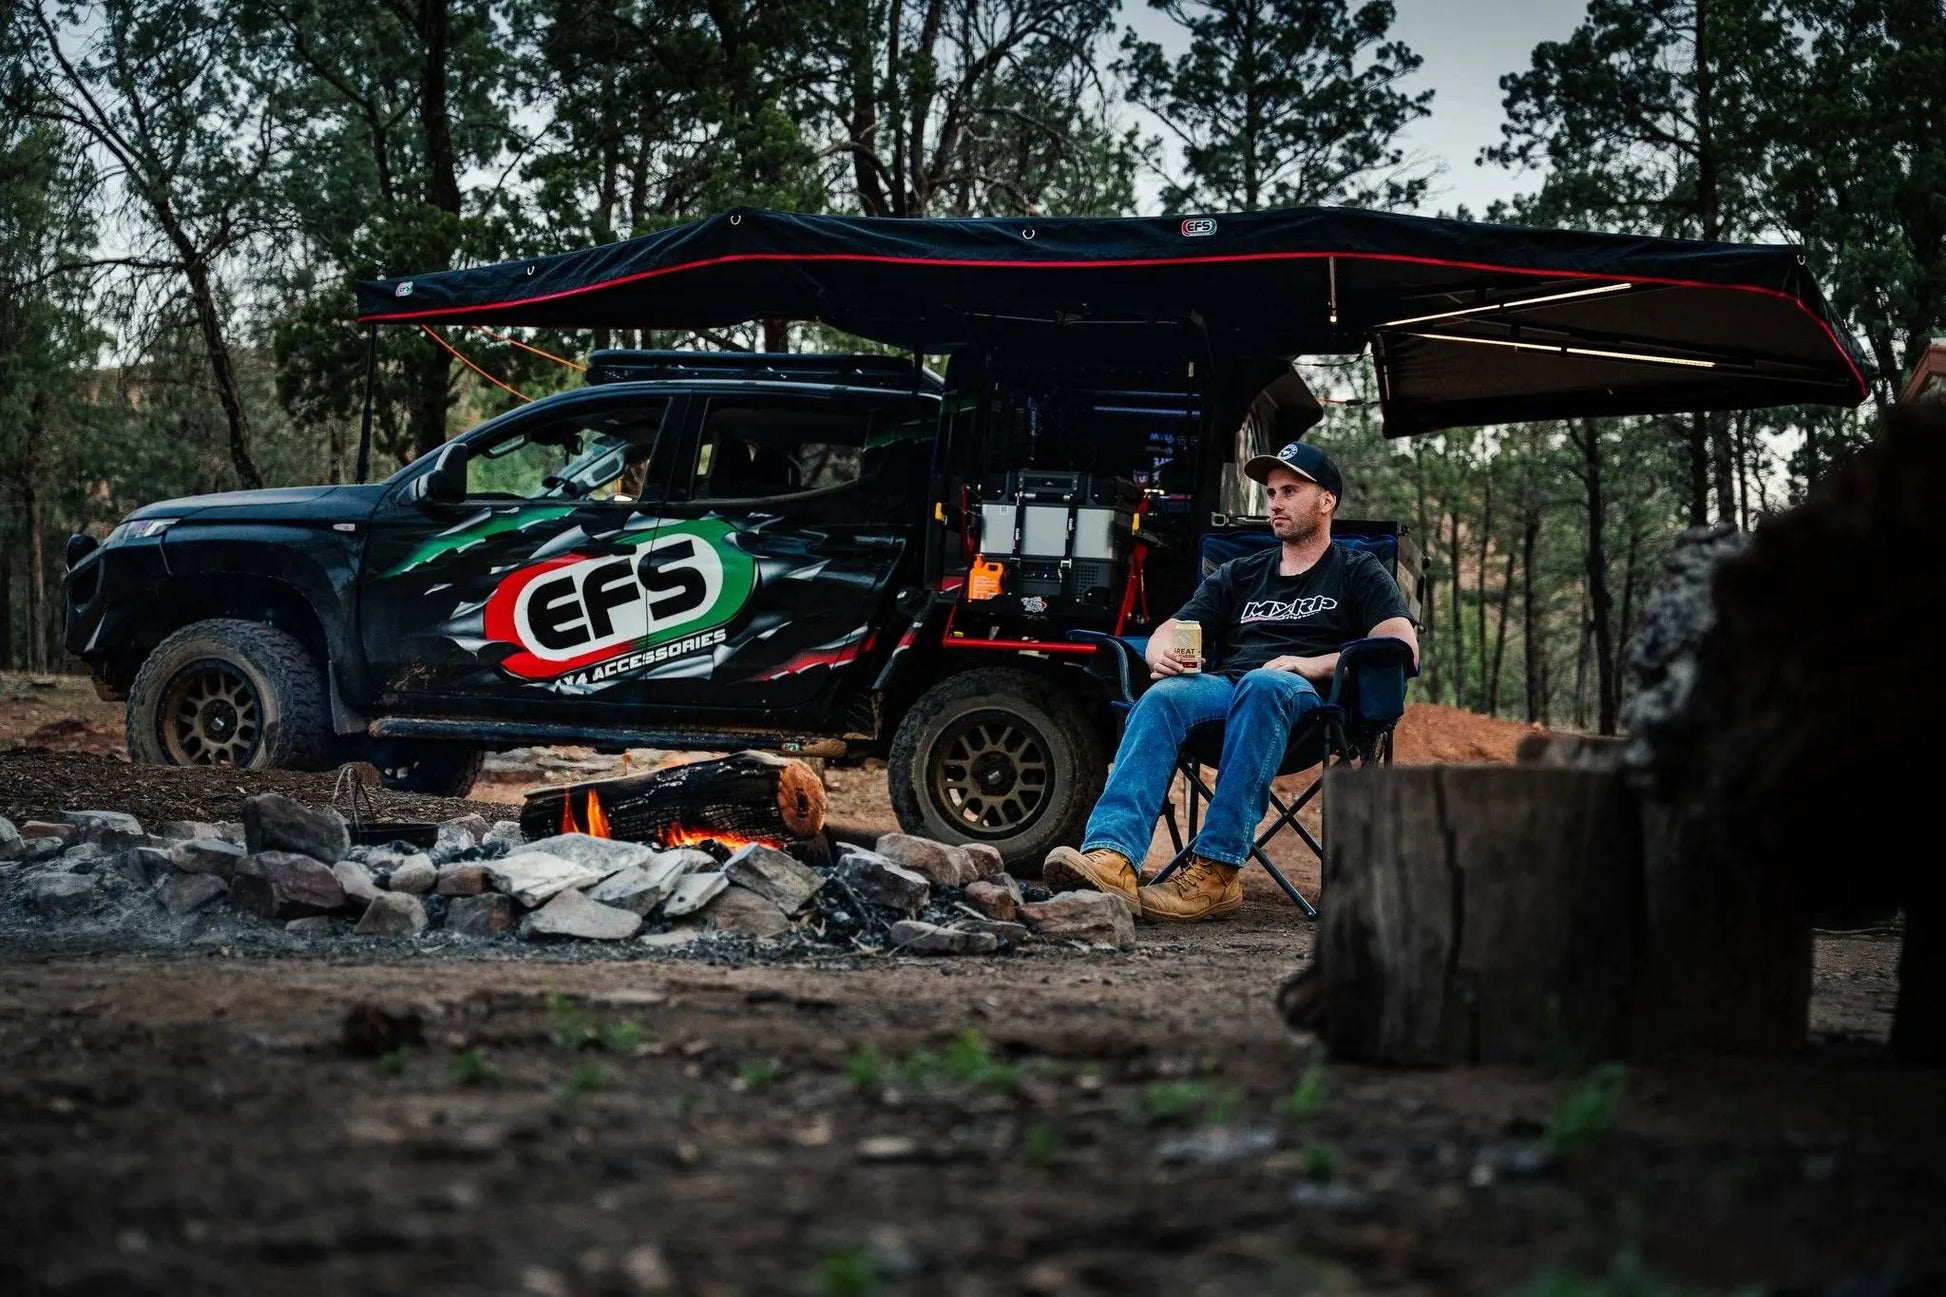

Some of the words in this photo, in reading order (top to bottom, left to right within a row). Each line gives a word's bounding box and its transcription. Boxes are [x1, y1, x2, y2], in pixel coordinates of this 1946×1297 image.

[1187, 221, 1211, 232] EFS
[527, 540, 707, 650] EFS
[592, 628, 727, 682] ACCESSORIES
